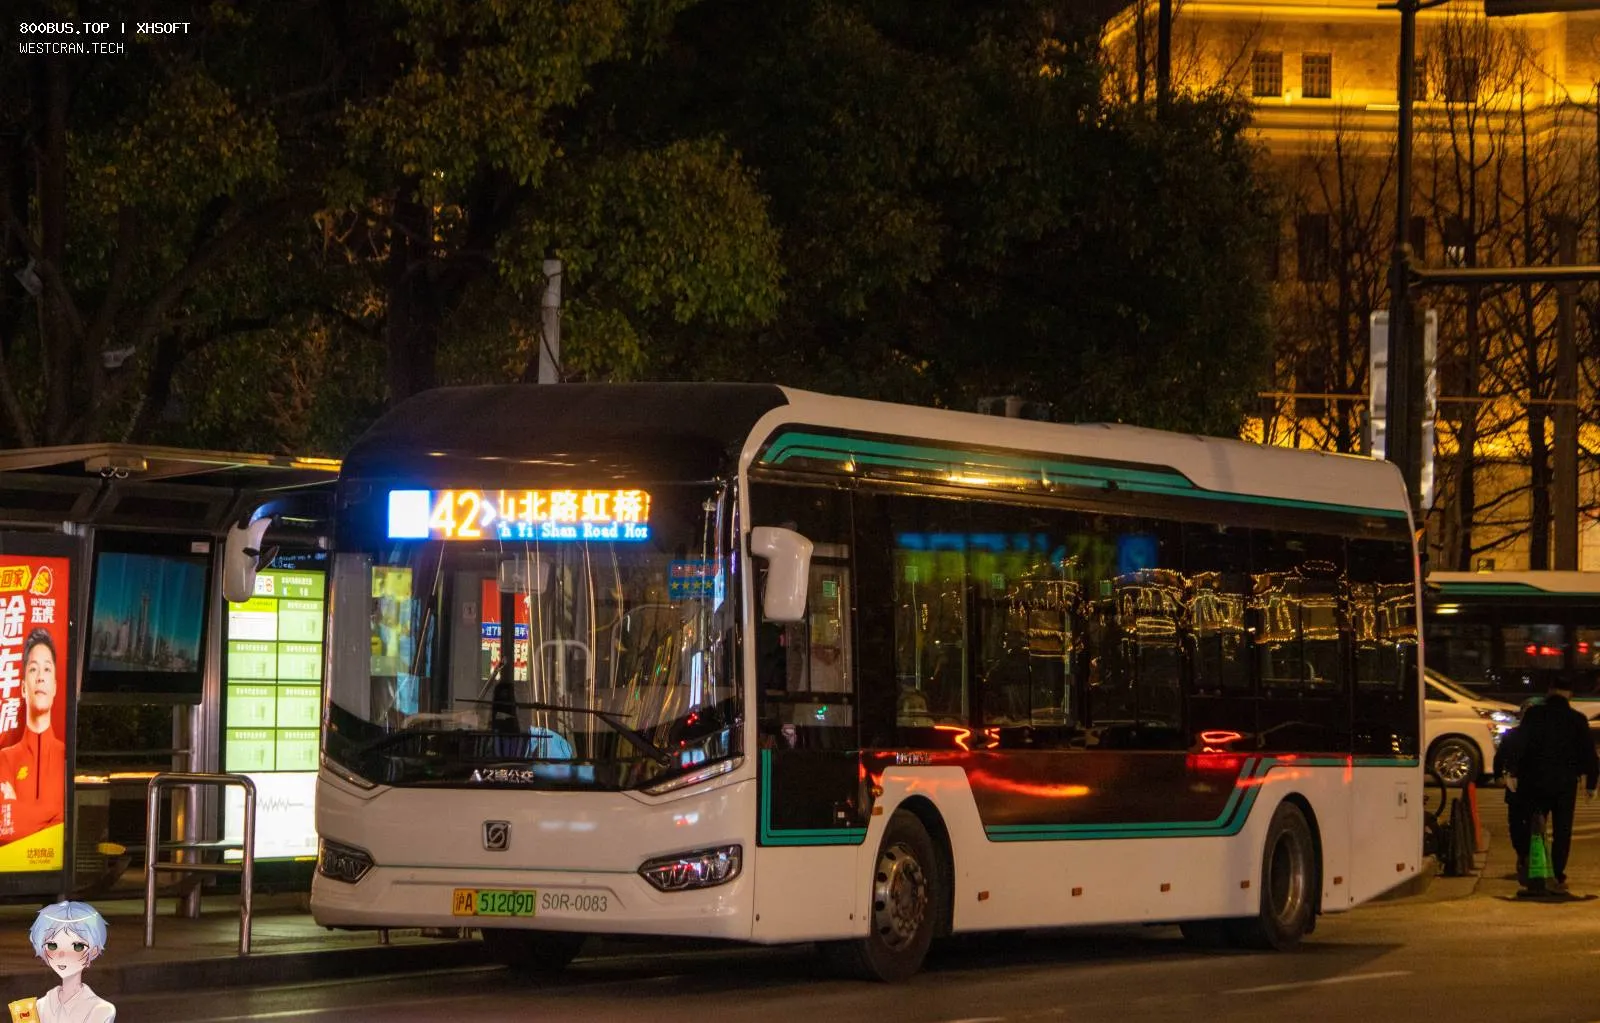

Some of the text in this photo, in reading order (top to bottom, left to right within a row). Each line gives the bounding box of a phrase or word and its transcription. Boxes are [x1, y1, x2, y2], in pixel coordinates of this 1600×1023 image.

[498, 489, 651, 523] 山北路虹桥
[518, 522, 533, 538] Yi
[541, 522, 577, 538] Shan
[583, 522, 618, 538] Road
[455, 892, 473, 912] 沪A
